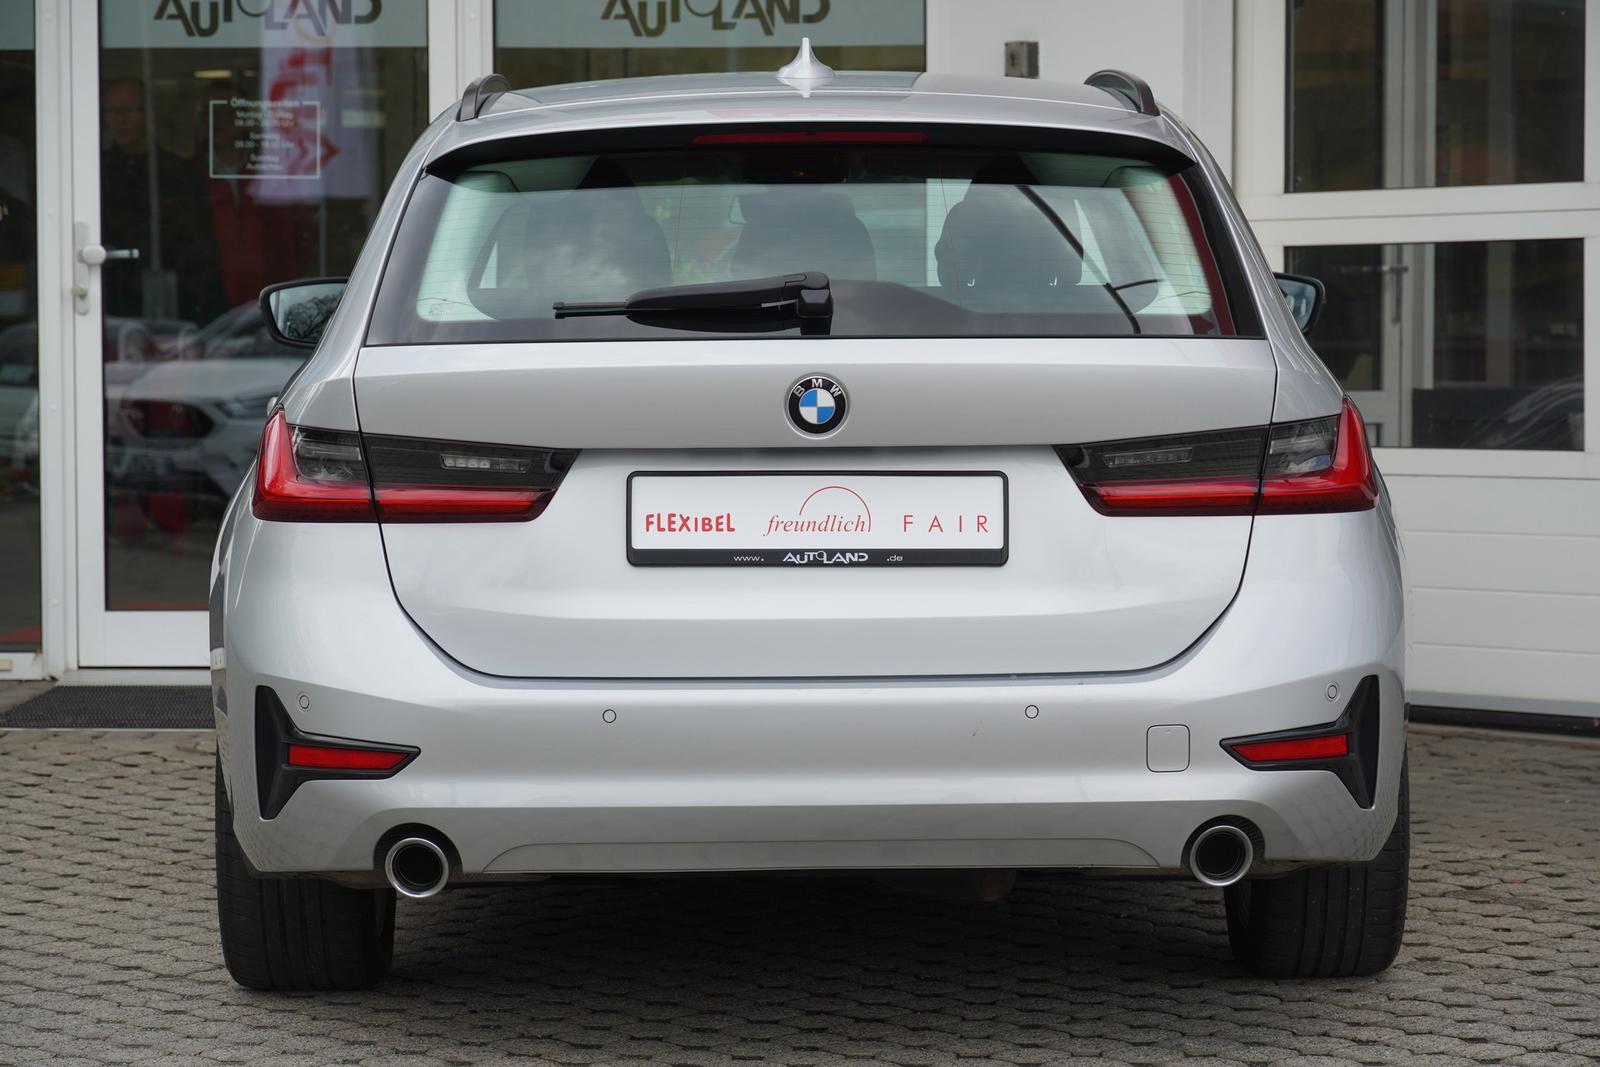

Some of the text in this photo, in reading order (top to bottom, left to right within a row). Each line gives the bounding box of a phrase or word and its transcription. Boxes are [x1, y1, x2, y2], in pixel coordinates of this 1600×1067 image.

[793, 378, 842, 397] BMW
[645, 513, 735, 532] FLEXIBEL
[763, 514, 867, 536] freundlich
